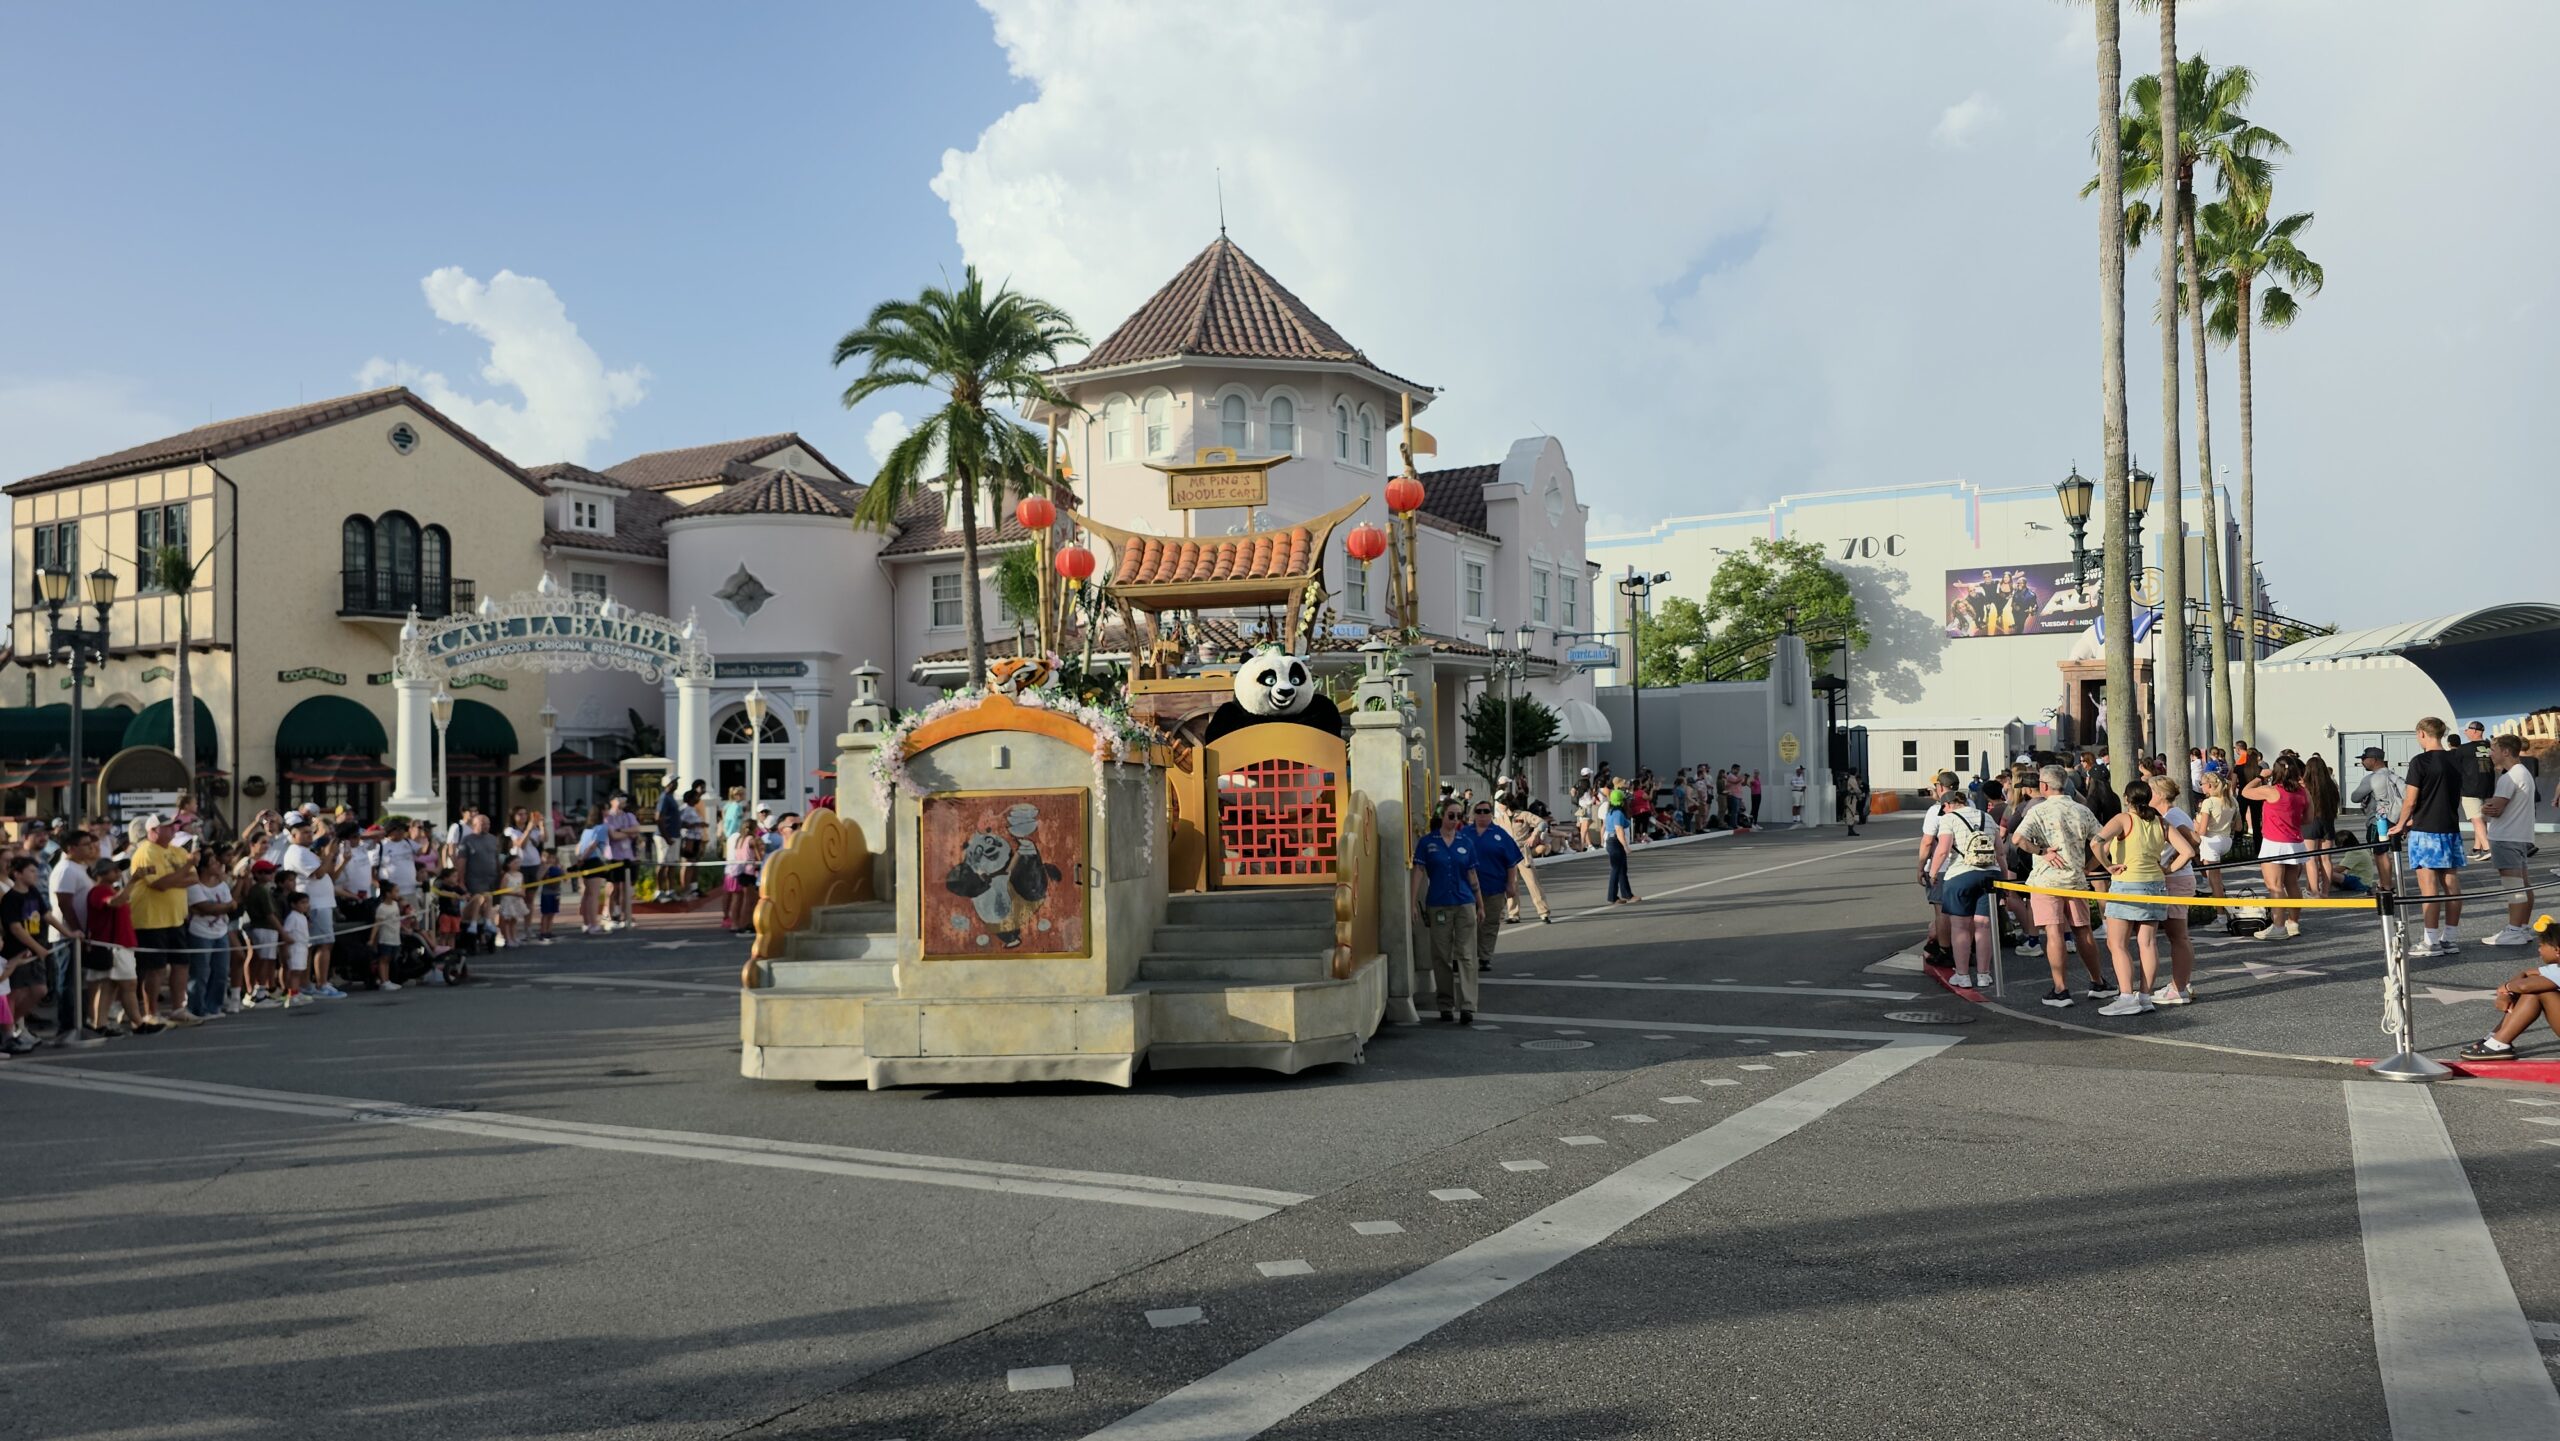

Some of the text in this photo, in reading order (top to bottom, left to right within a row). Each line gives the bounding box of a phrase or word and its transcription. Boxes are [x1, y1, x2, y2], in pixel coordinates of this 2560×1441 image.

[1189, 476, 1206, 488] MR
[1176, 488, 1258, 502] NOODLE CART
[526, 616, 562, 638] LA
[570, 618, 673, 654] BAMBA
[534, 640, 586, 652] ORIGINAL
[591, 641, 655, 662] RESTAURANT
[2492, 712, 2560, 740] HOLLY
[635, 787, 660, 808] VIP
